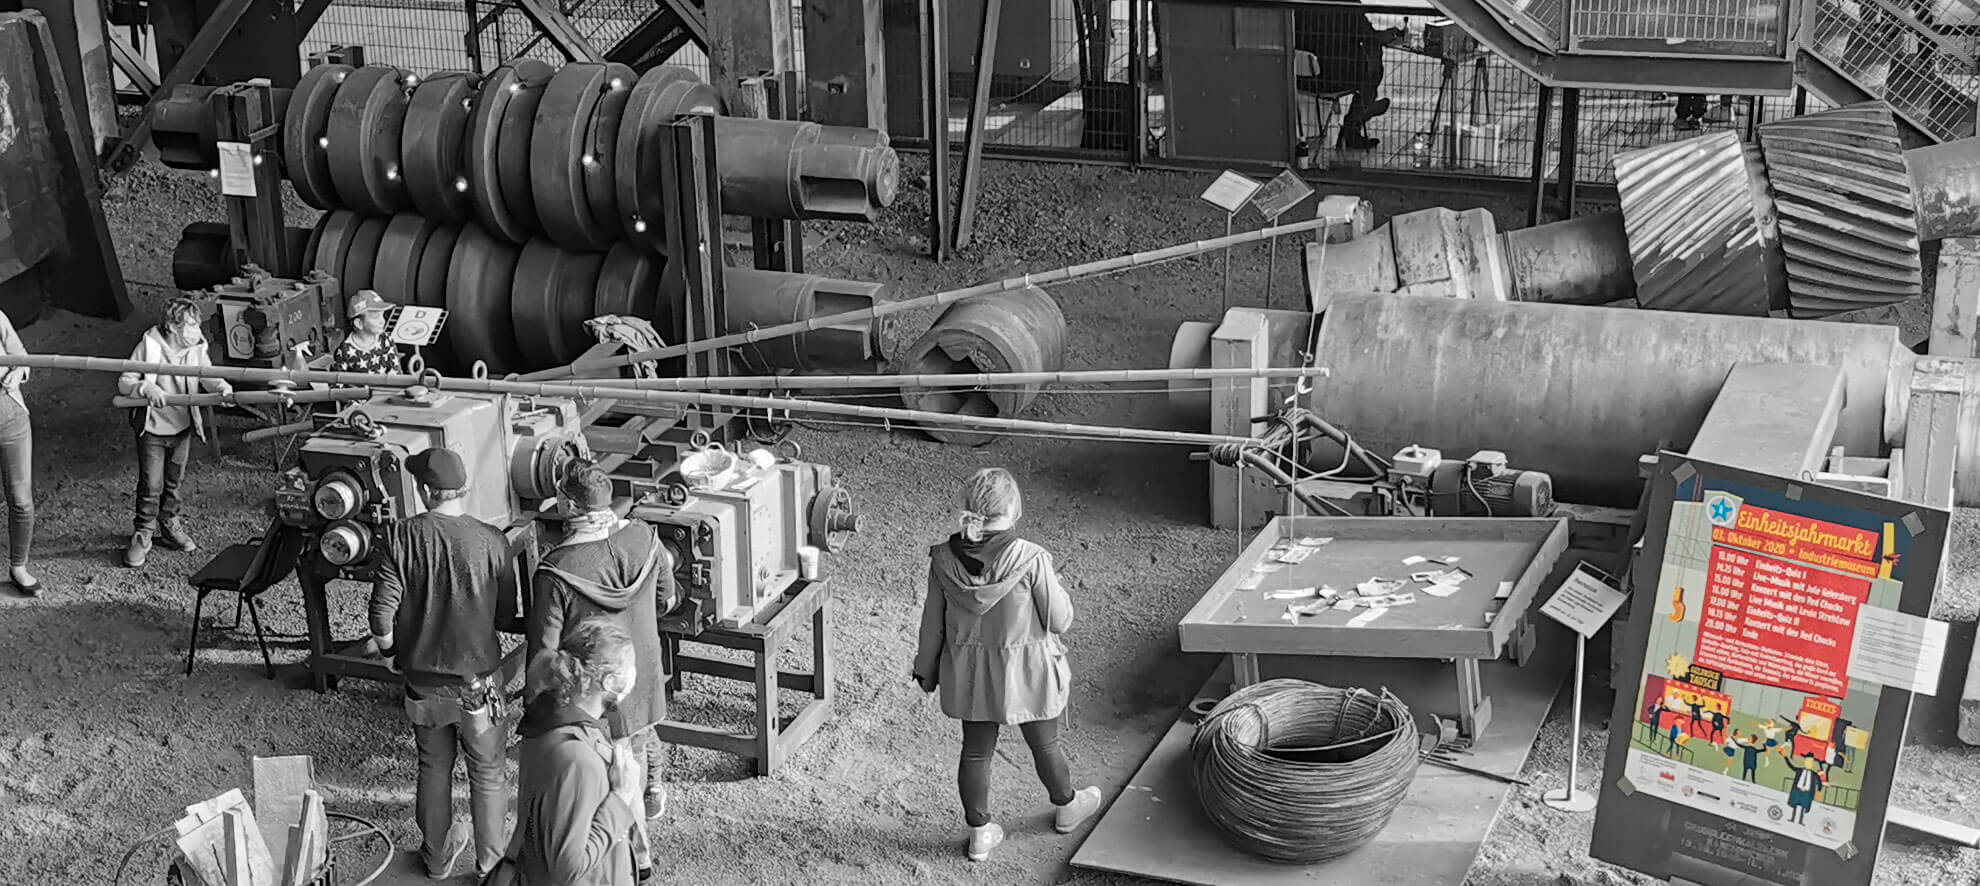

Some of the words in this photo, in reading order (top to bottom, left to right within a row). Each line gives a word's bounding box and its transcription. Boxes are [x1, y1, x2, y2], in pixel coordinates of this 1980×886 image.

[1738, 510, 1872, 557] Einheitsjahrmarkt
[1712, 528, 1726, 541] 03.
[1728, 532, 1761, 549] Oktober
[1764, 539, 1786, 555] 2020
[1799, 549, 1877, 576] Industriemuseum
[1732, 565, 1745, 576] Uhr
[1753, 571, 1791, 588] Live-Musik
[1792, 582, 1806, 591] mit
[1736, 555, 1749, 566] Uhr
[1756, 560, 1801, 579] Einheits-Quiz
[1730, 589, 1744, 600] Uhr
[1749, 594, 1763, 605] Live
[1763, 597, 1785, 610] Musik
[1785, 604, 1799, 614] mit
[1732, 577, 1745, 588] Uhr
[1751, 582, 1778, 596] Konzert
[1778, 591, 1793, 600] mit
[1793, 593, 1806, 603] den
[1806, 595, 1820, 607] Red
[1820, 600, 1844, 613] Chucks
[1727, 600, 1740, 610] Uhr
[1746, 604, 1793, 624] Einheits-Quiz
[1724, 611, 1737, 622] Uhr
[1745, 617, 1772, 631] Konzert
[1771, 625, 1785, 635] mit
[1786, 627, 1799, 638] den
[1800, 630, 1813, 642] Red
[1813, 634, 1837, 647] Chucks
[1724, 623, 1738, 634] Uhr
[1742, 628, 1759, 640] Ende
